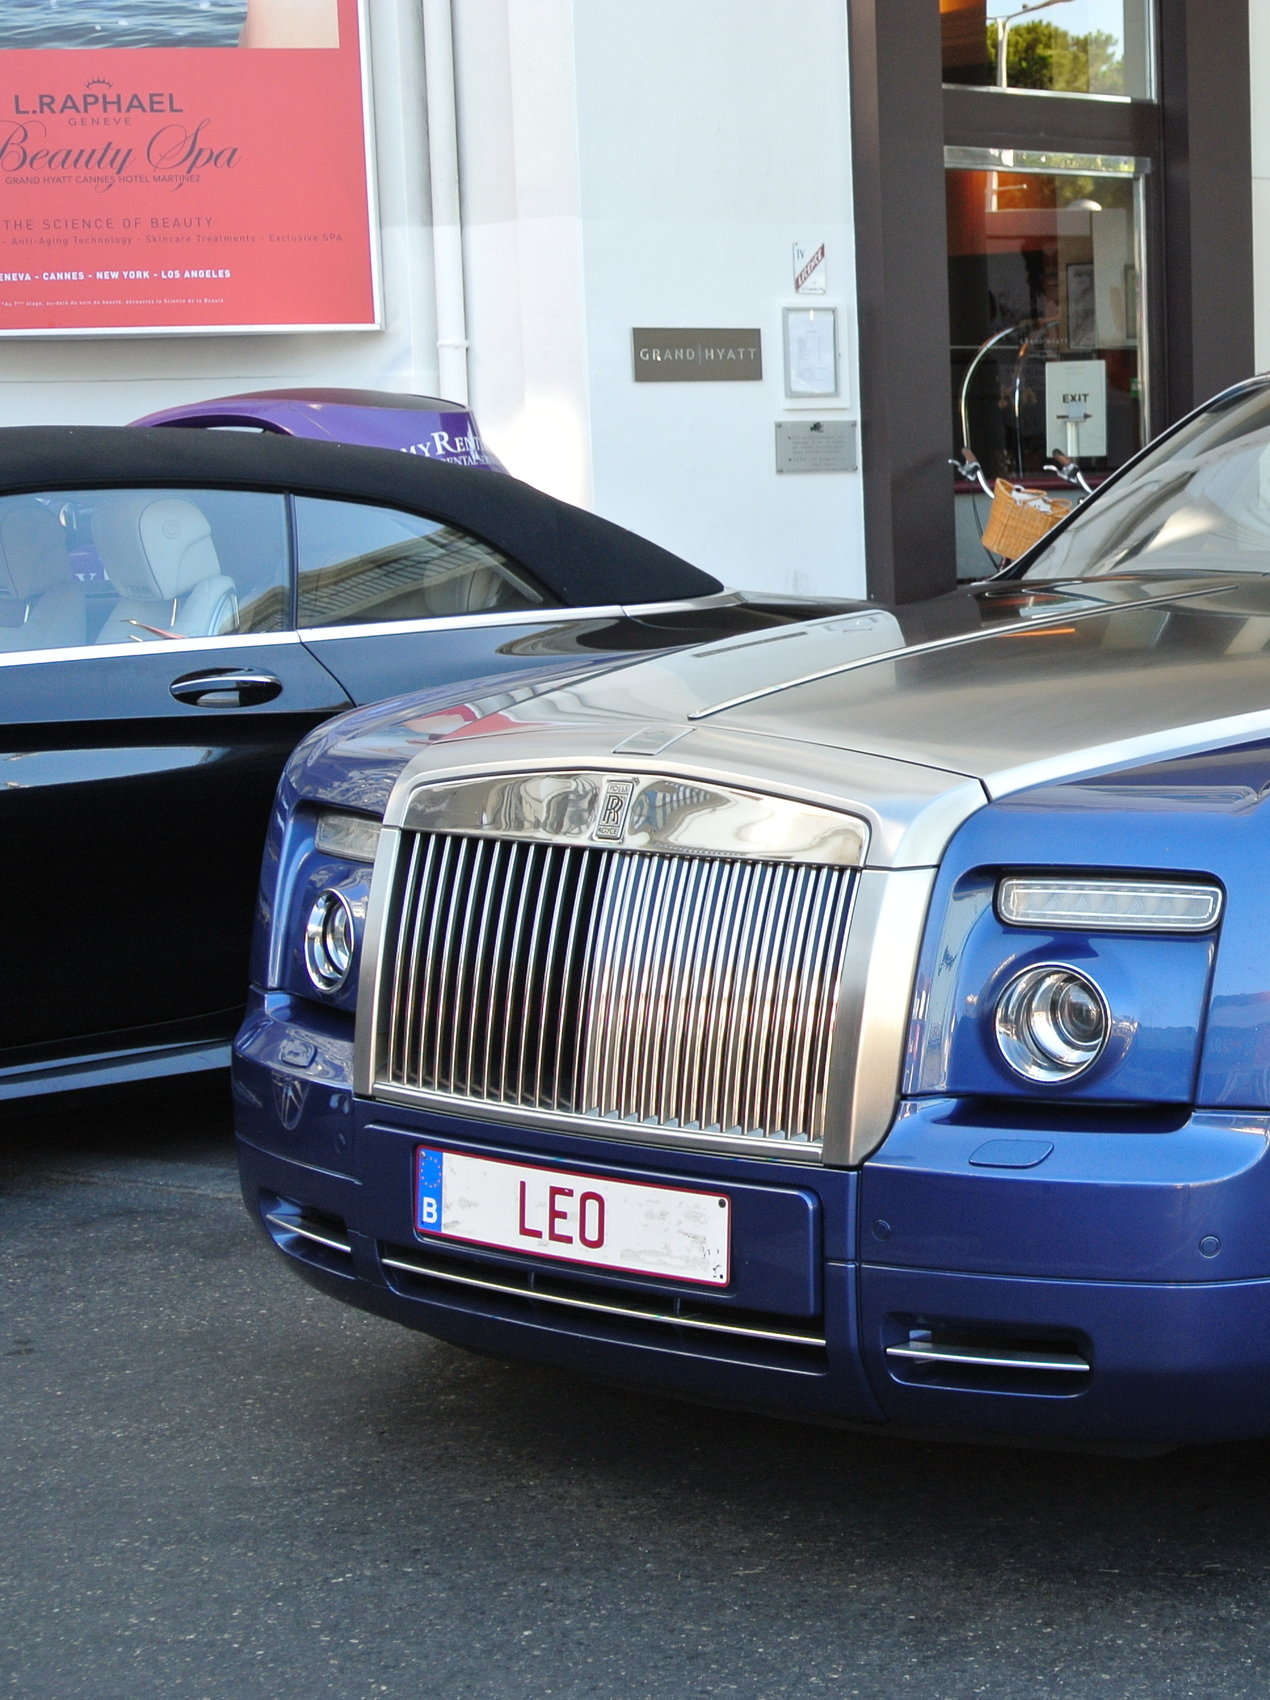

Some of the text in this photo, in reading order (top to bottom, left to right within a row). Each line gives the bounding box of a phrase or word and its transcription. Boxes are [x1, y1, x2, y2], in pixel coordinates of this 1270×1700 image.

[14, 93, 183, 114] L.RAPHAEL
[68, 117, 131, 126] GENEVE
[0, 118, 242, 193] Beauty Spa
[5, 174, 201, 184] GRAND HYATT CANNES HOTEL MARTINEZ
[3, 217, 213, 230] THE SCIENCE OF BEAUTY
[12, 236, 68, 246] Anti-Aging
[73, 235, 132, 245] Technology
[145, 235, 191, 243] Skincare
[269, 233, 318, 242] Exclusive
[322, 233, 343, 242] SPA
[43, 271, 85, 280] CANNES
[96, 271, 119, 279] NEW
[123, 271, 149, 279] YORK
[161, 270, 180, 278] LOS
[184, 269, 231, 279] ANGELES
[798, 249, 822, 287] LICENCE
[640, 348, 756, 361] GRAND HYATT
[1062, 393, 1089, 403] EXIT
[422, 1196, 438, 1224] B
[518, 1180, 606, 1250] LEO
